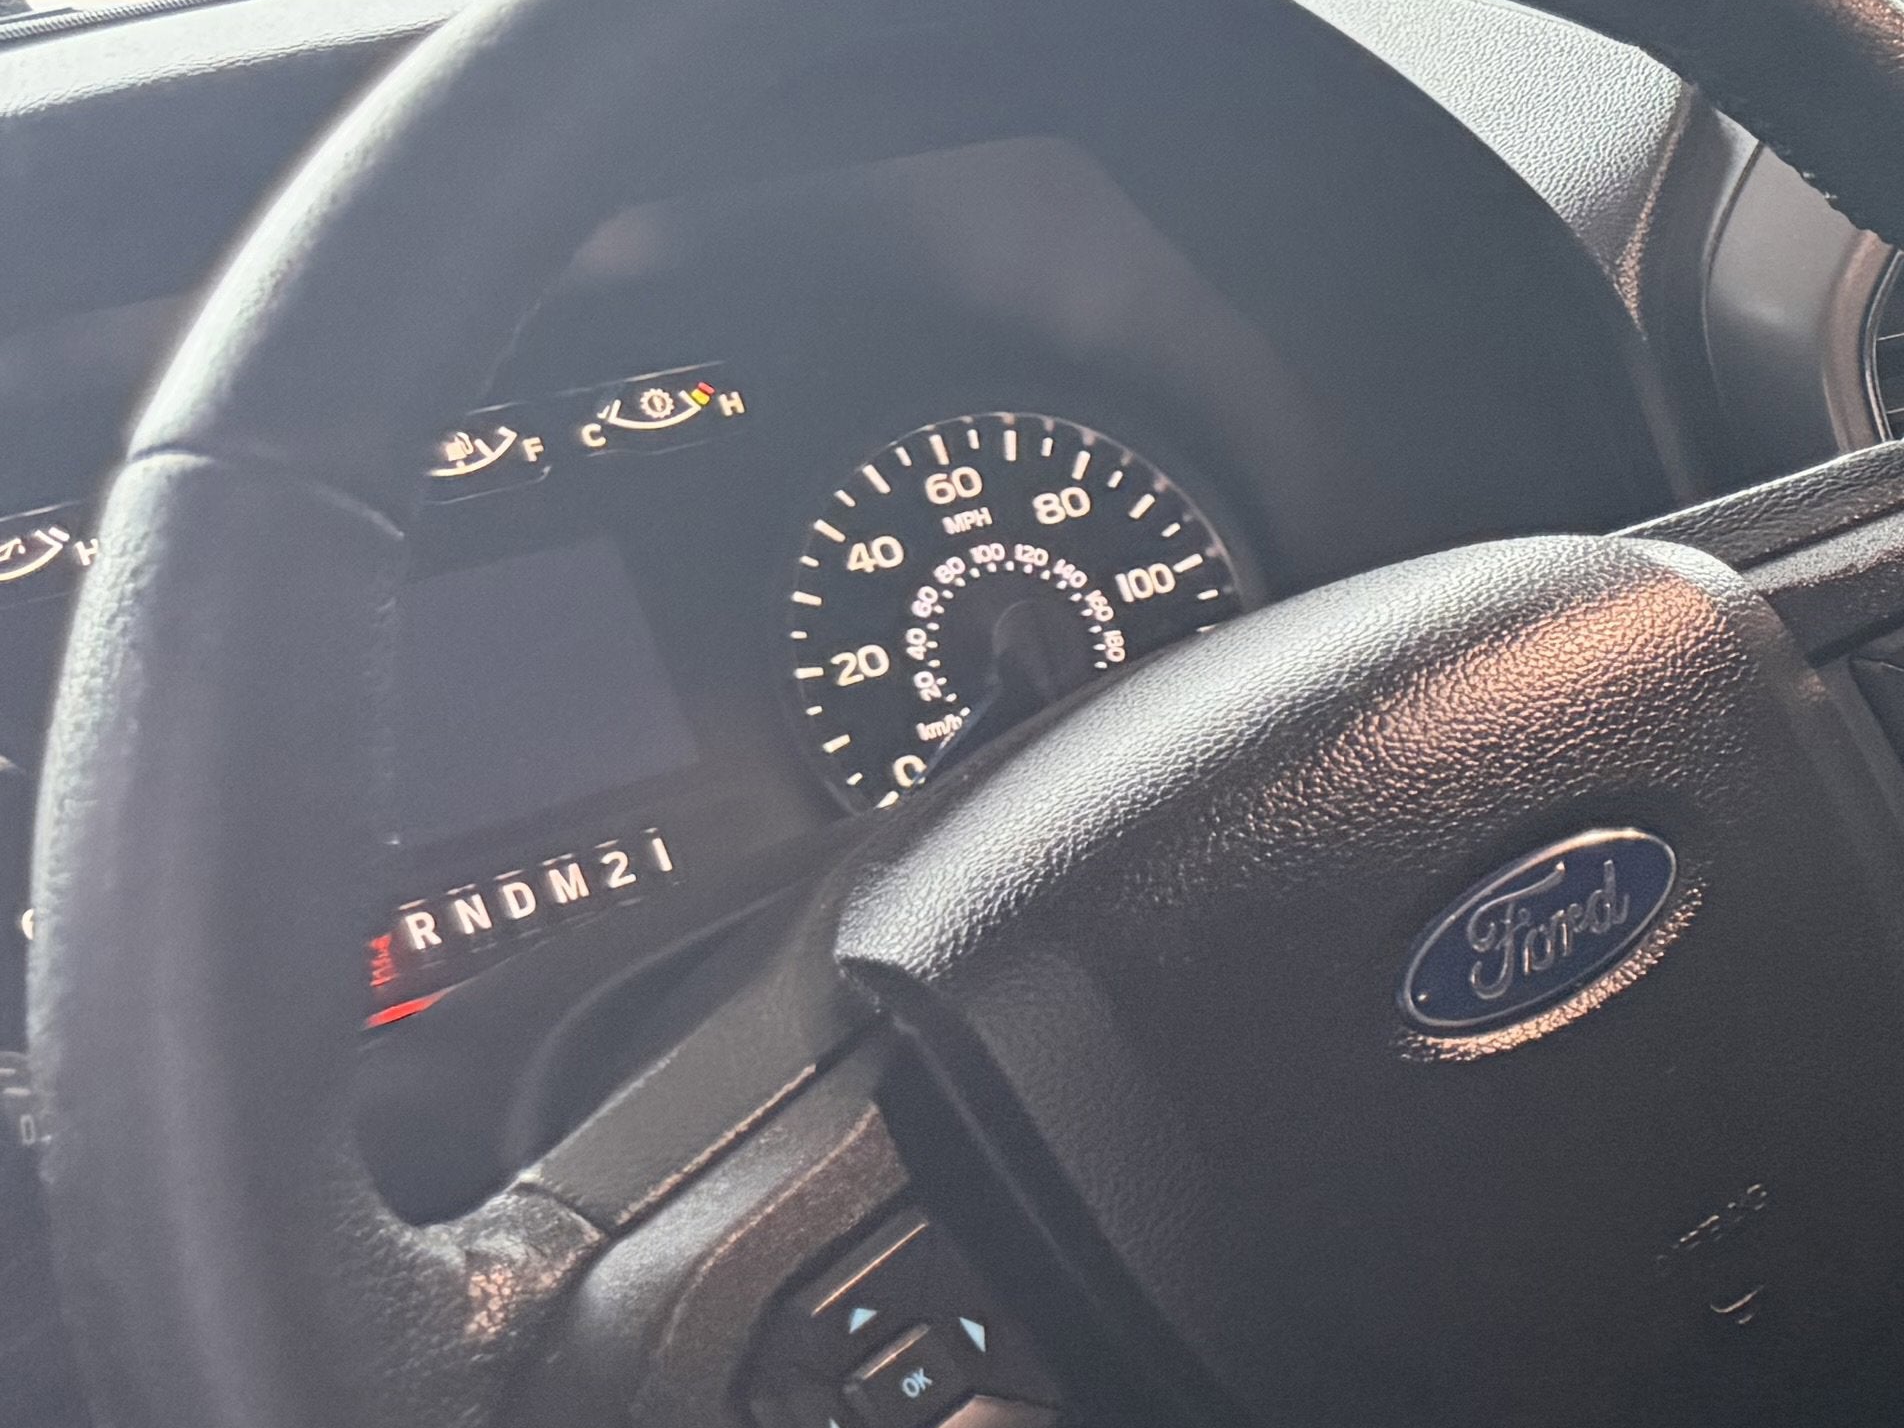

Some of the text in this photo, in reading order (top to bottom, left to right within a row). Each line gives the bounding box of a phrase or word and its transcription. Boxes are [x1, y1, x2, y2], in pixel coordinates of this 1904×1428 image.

[718, 391, 745, 417] H
[523, 437, 545, 461] F
[581, 423, 607, 448] C
[924, 467, 984, 505] 60
[942, 507, 993, 534] MPH
[1032, 487, 1092, 525] 80
[846, 536, 904, 572] 40
[969, 543, 1006, 565] 100
[1014, 544, 1049, 567] 120
[933, 556, 966, 585] 80
[1053, 558, 1088, 589] 140
[1115, 563, 1176, 603] 100
[911, 586, 939, 619] 60
[906, 627, 927, 661] 40
[1103, 630, 1126, 663] 180
[831, 645, 890, 686] 20
[916, 714, 963, 741] km/h
[893, 755, 927, 787] 0
[404, 912, 442, 950] R
[454, 894, 492, 935] N
[502, 882, 536, 920] D
[549, 863, 590, 904] M
[601, 851, 638, 889] 2
[1467, 860, 1630, 1000] Ford
[902, 1367, 933, 1398] OK
